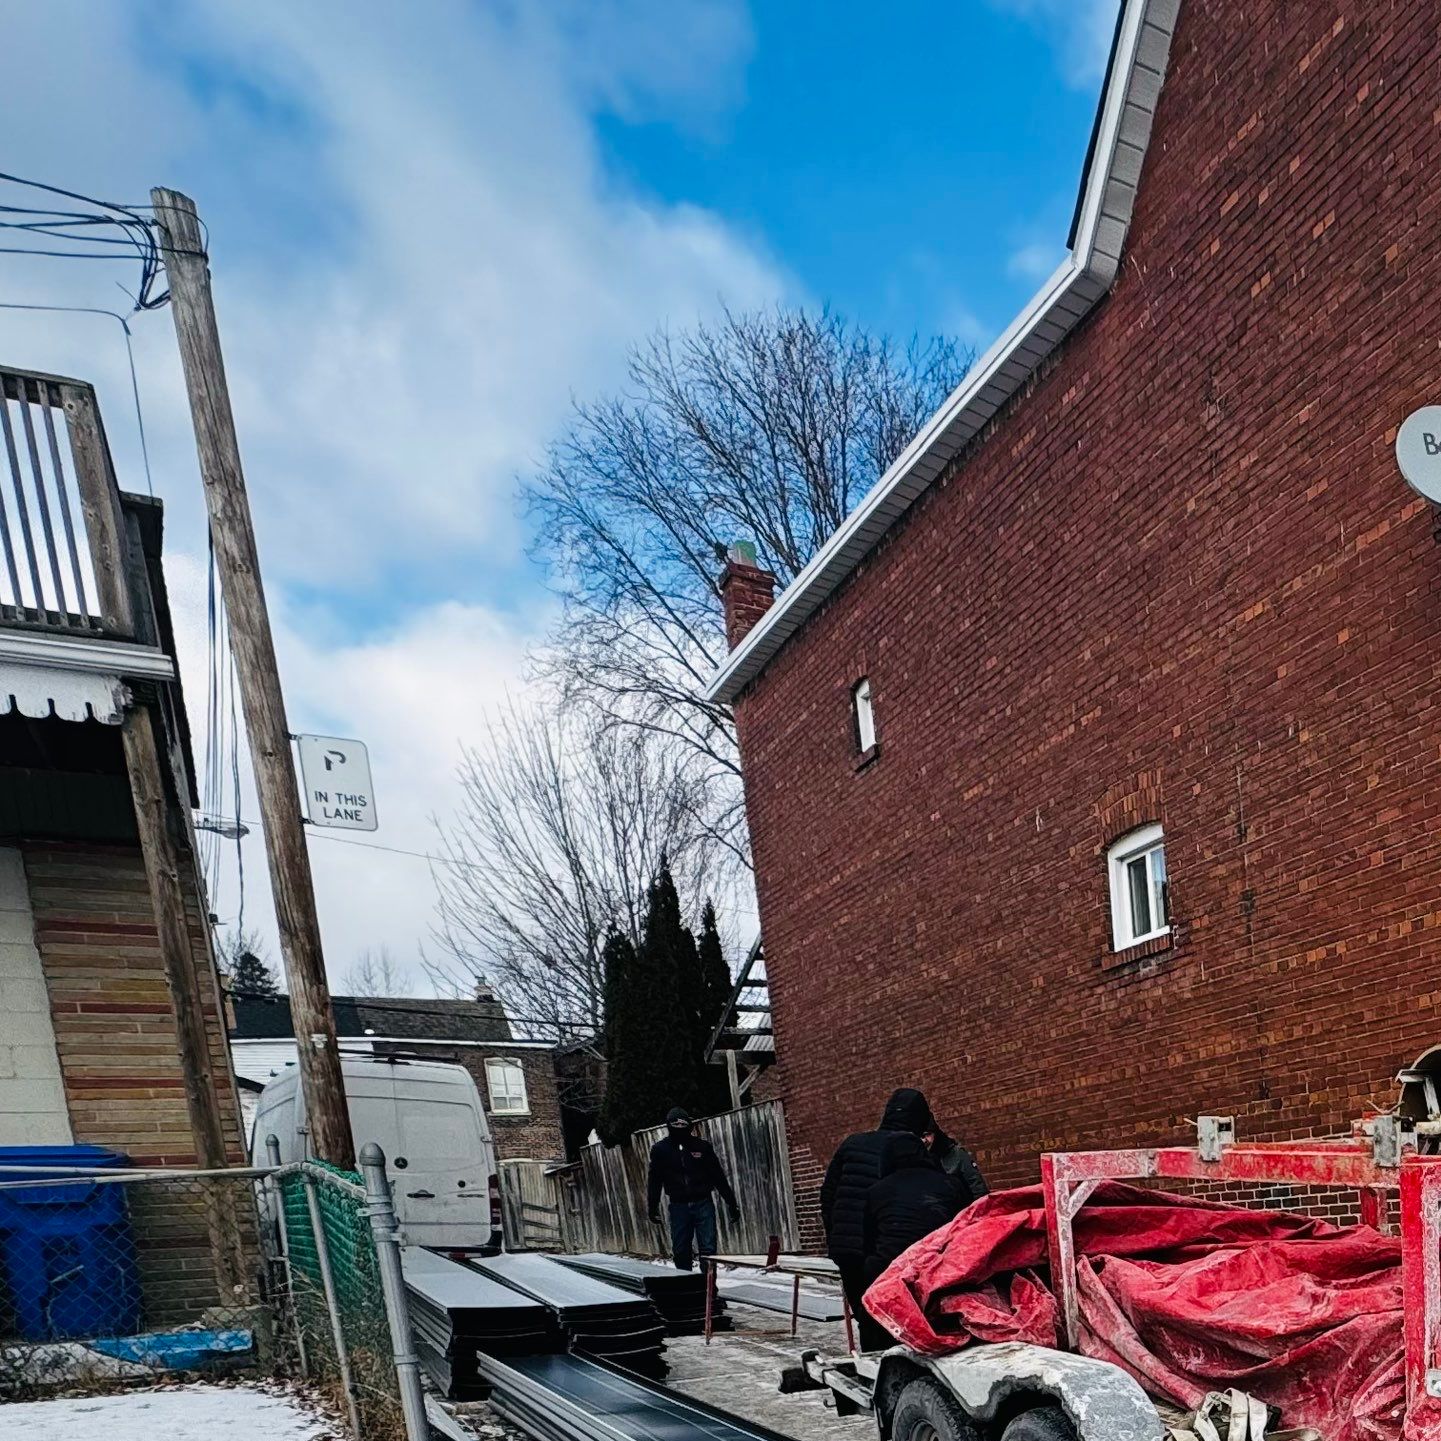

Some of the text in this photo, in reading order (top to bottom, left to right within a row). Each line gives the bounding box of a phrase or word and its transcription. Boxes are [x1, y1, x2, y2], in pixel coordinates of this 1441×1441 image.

[314, 790, 367, 807] IN THIS
[323, 806, 364, 822] LANE
